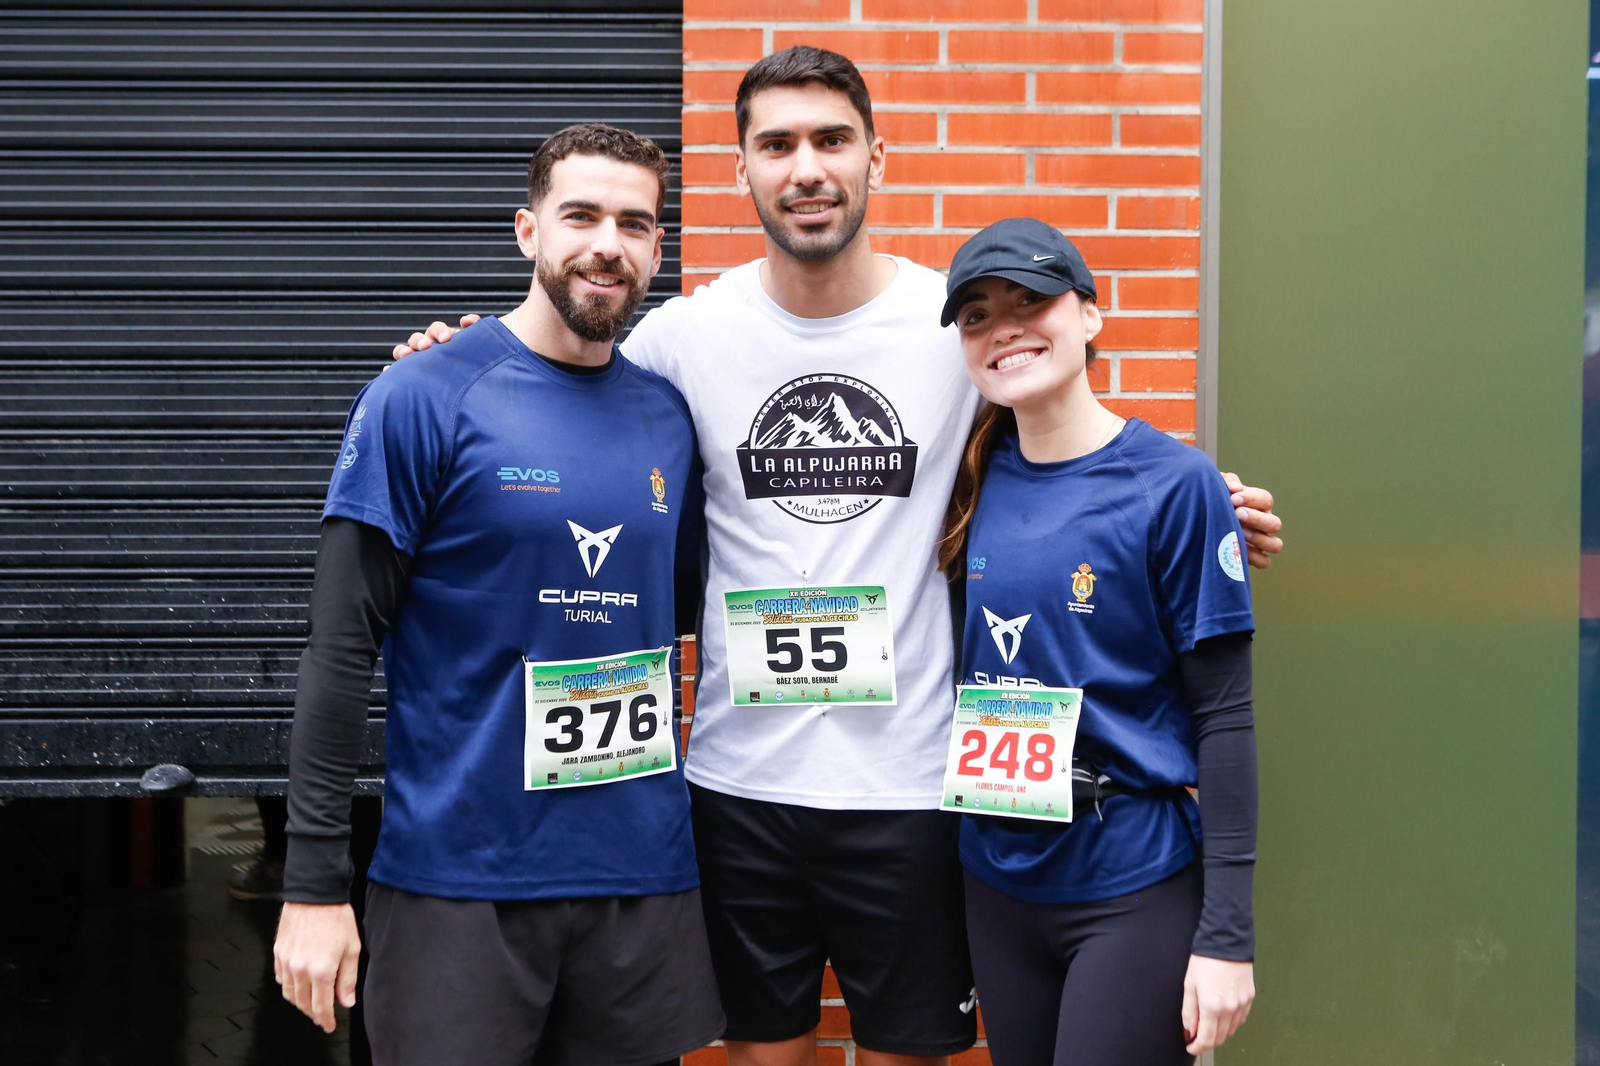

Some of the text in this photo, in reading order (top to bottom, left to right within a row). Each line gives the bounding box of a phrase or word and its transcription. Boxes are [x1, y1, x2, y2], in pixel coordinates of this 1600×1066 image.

[756, 376, 896, 424] NEVER STOP EXPLORING
[751, 452, 902, 473] LA ALPUJARRA
[497, 466, 560, 483] EVOS
[769, 476, 884, 488] CAPILEIRA
[792, 501, 864, 517] MULHACEN
[968, 557, 986, 570] VOS
[539, 589, 638, 607] CUPRA
[800, 589, 827, 597] EDICIÓN
[755, 598, 807, 616] CARRERA
[809, 596, 859, 615] NAVIDAD
[565, 609, 612, 624] TURIAL
[820, 614, 859, 623] ALGECIRAS
[765, 627, 848, 674] 55
[562, 671, 610, 693] CARRERA
[612, 664, 649, 687] NAVIDAD
[776, 675, 838, 686] BÁEZ SOTO, BERNABÉ
[976, 699, 1013, 718] CARRERA
[1014, 700, 1053, 720] NAVIDAD
[544, 694, 658, 754] 376
[561, 746, 646, 765] JARA ZAMBONINO, ALEJANDRO
[957, 729, 1056, 782] 248
[975, 782, 993, 791] FLORES
[994, 784, 1015, 793] CAMPOS,
